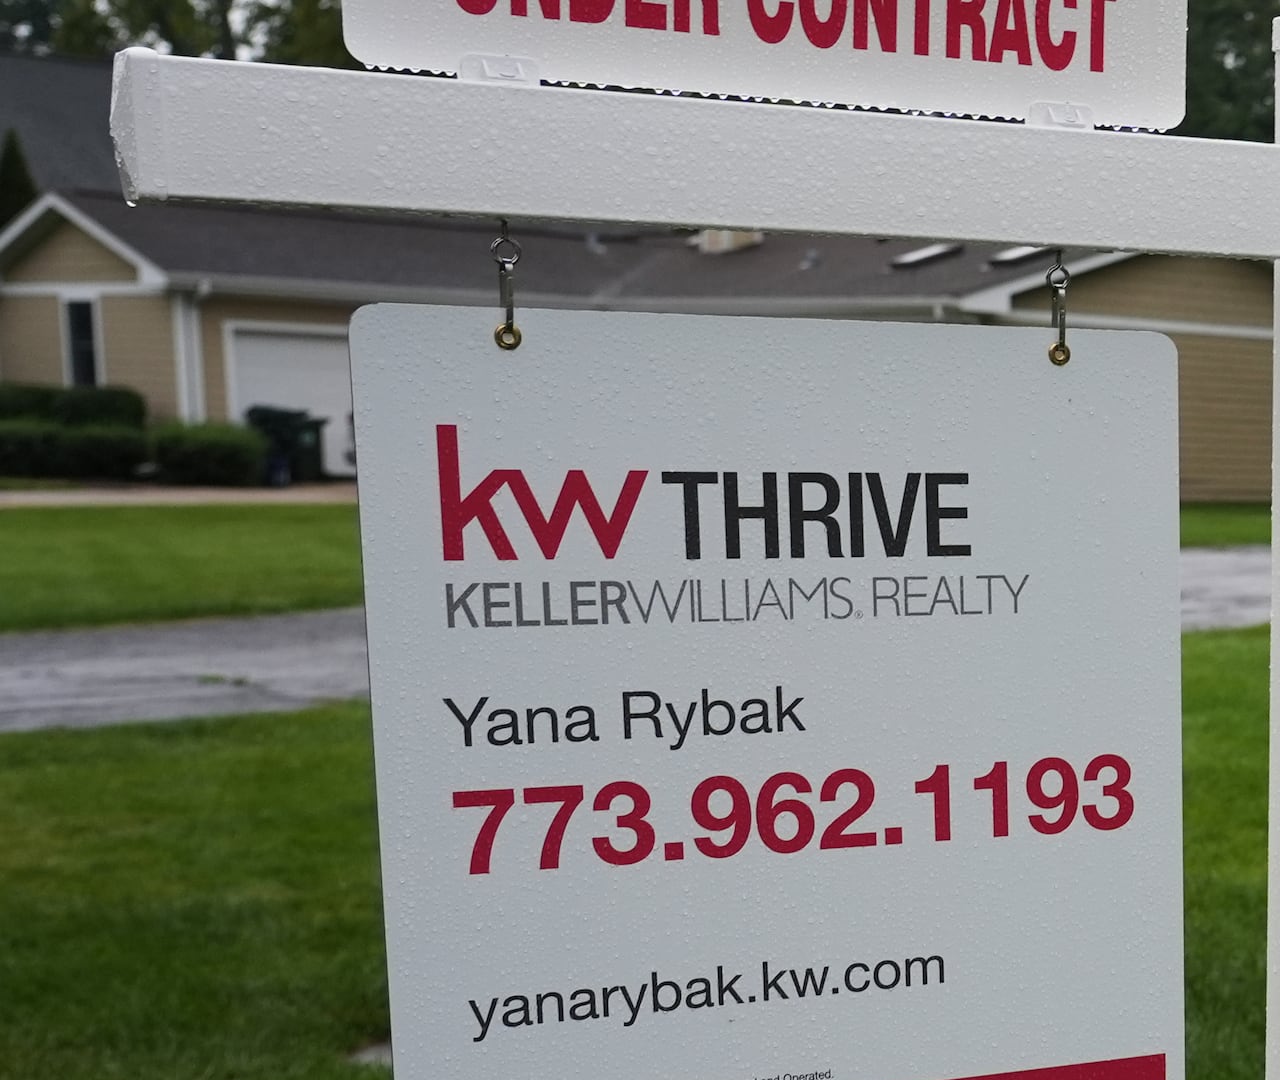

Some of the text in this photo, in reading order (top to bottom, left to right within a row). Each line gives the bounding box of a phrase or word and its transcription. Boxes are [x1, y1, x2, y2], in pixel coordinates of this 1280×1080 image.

[436, 424, 972, 562] kw THRIVE
[872, 574, 1030, 617] REALTY
[443, 685, 806, 751] Yana Rybak
[452, 753, 1136, 875] 773.962.1193
[469, 951, 946, 1043] yanarybak.kw.com
